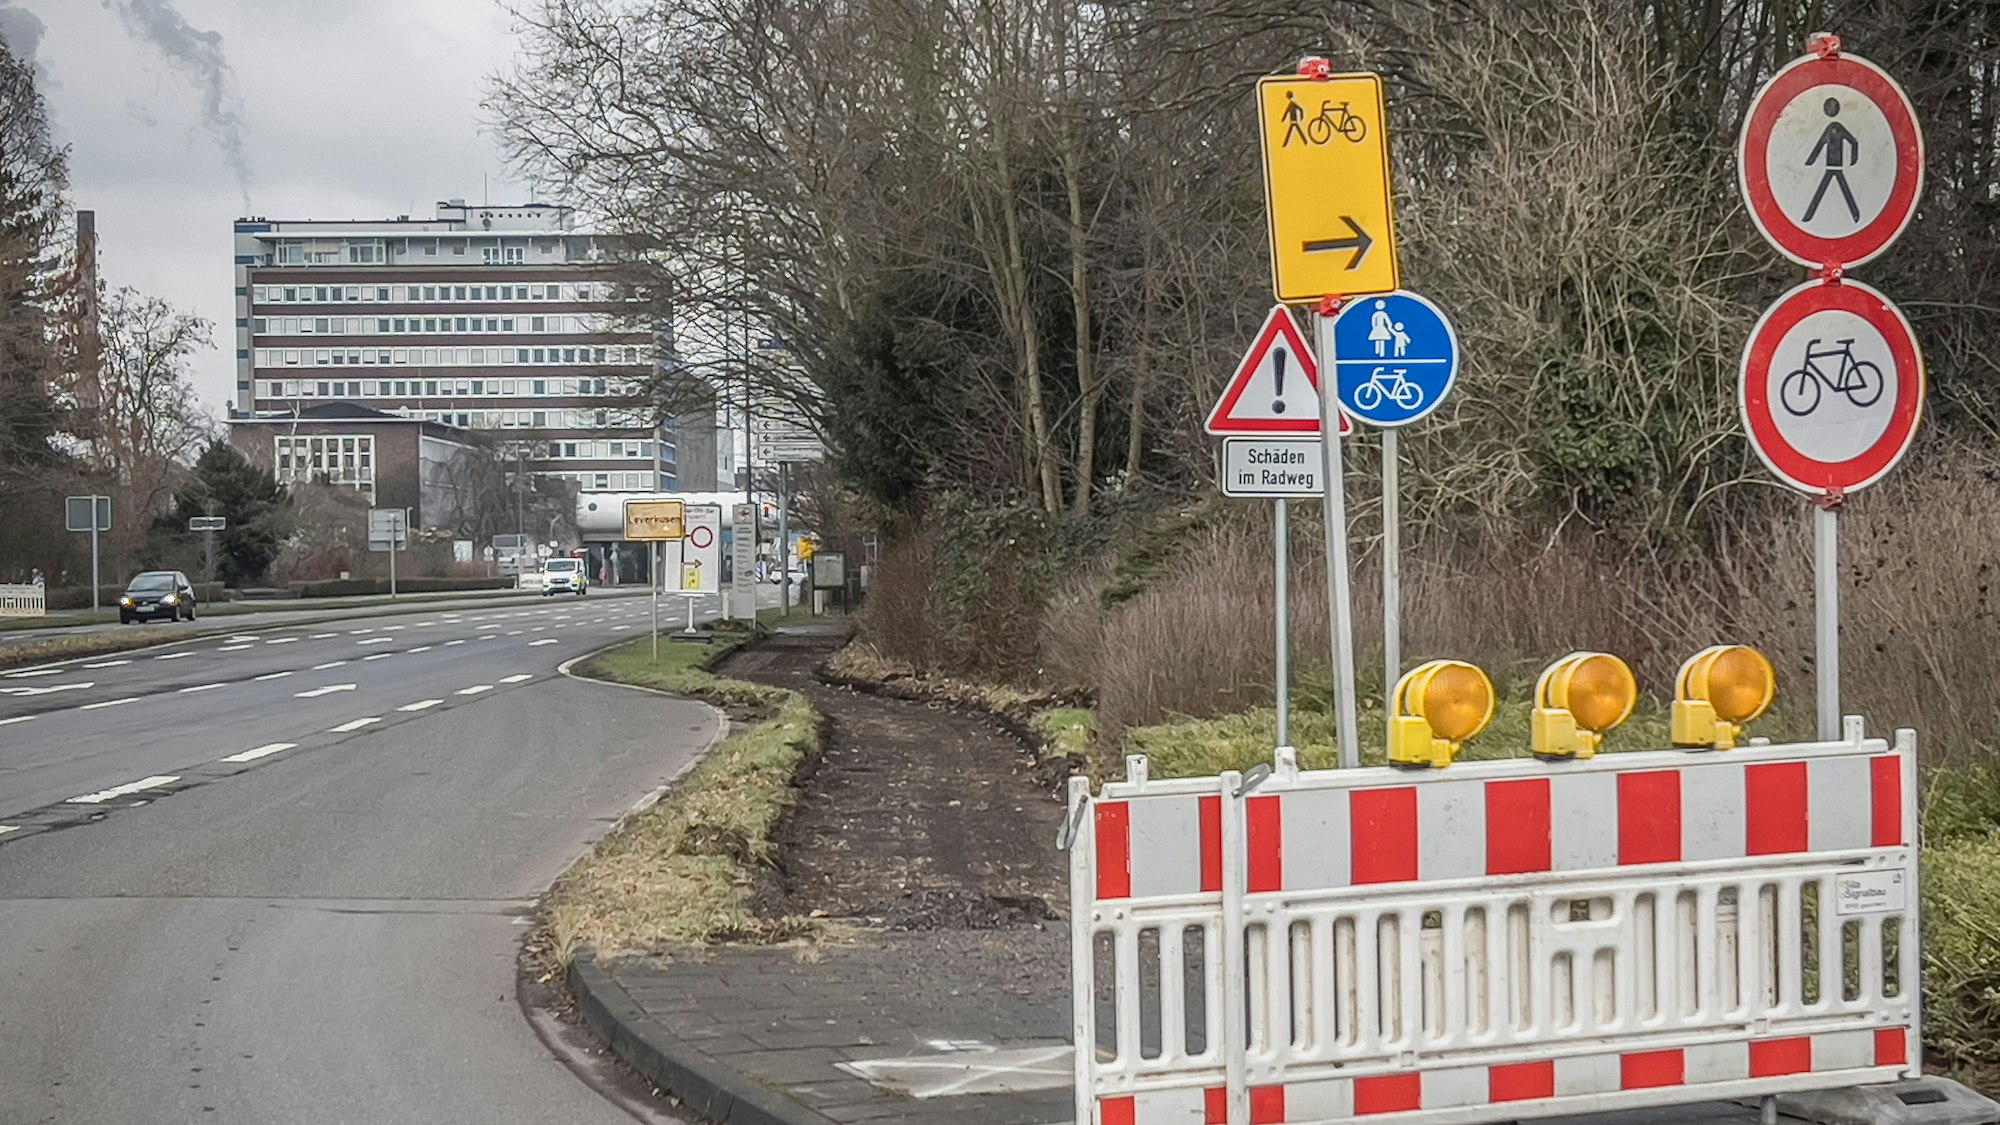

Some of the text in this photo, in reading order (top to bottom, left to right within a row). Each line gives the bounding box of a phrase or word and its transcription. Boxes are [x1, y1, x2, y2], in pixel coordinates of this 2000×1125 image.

[1248, 448, 1305, 464] Schäden
[1238, 468, 1314, 489] im Radweg
[628, 515, 682, 525] Leverkusen
